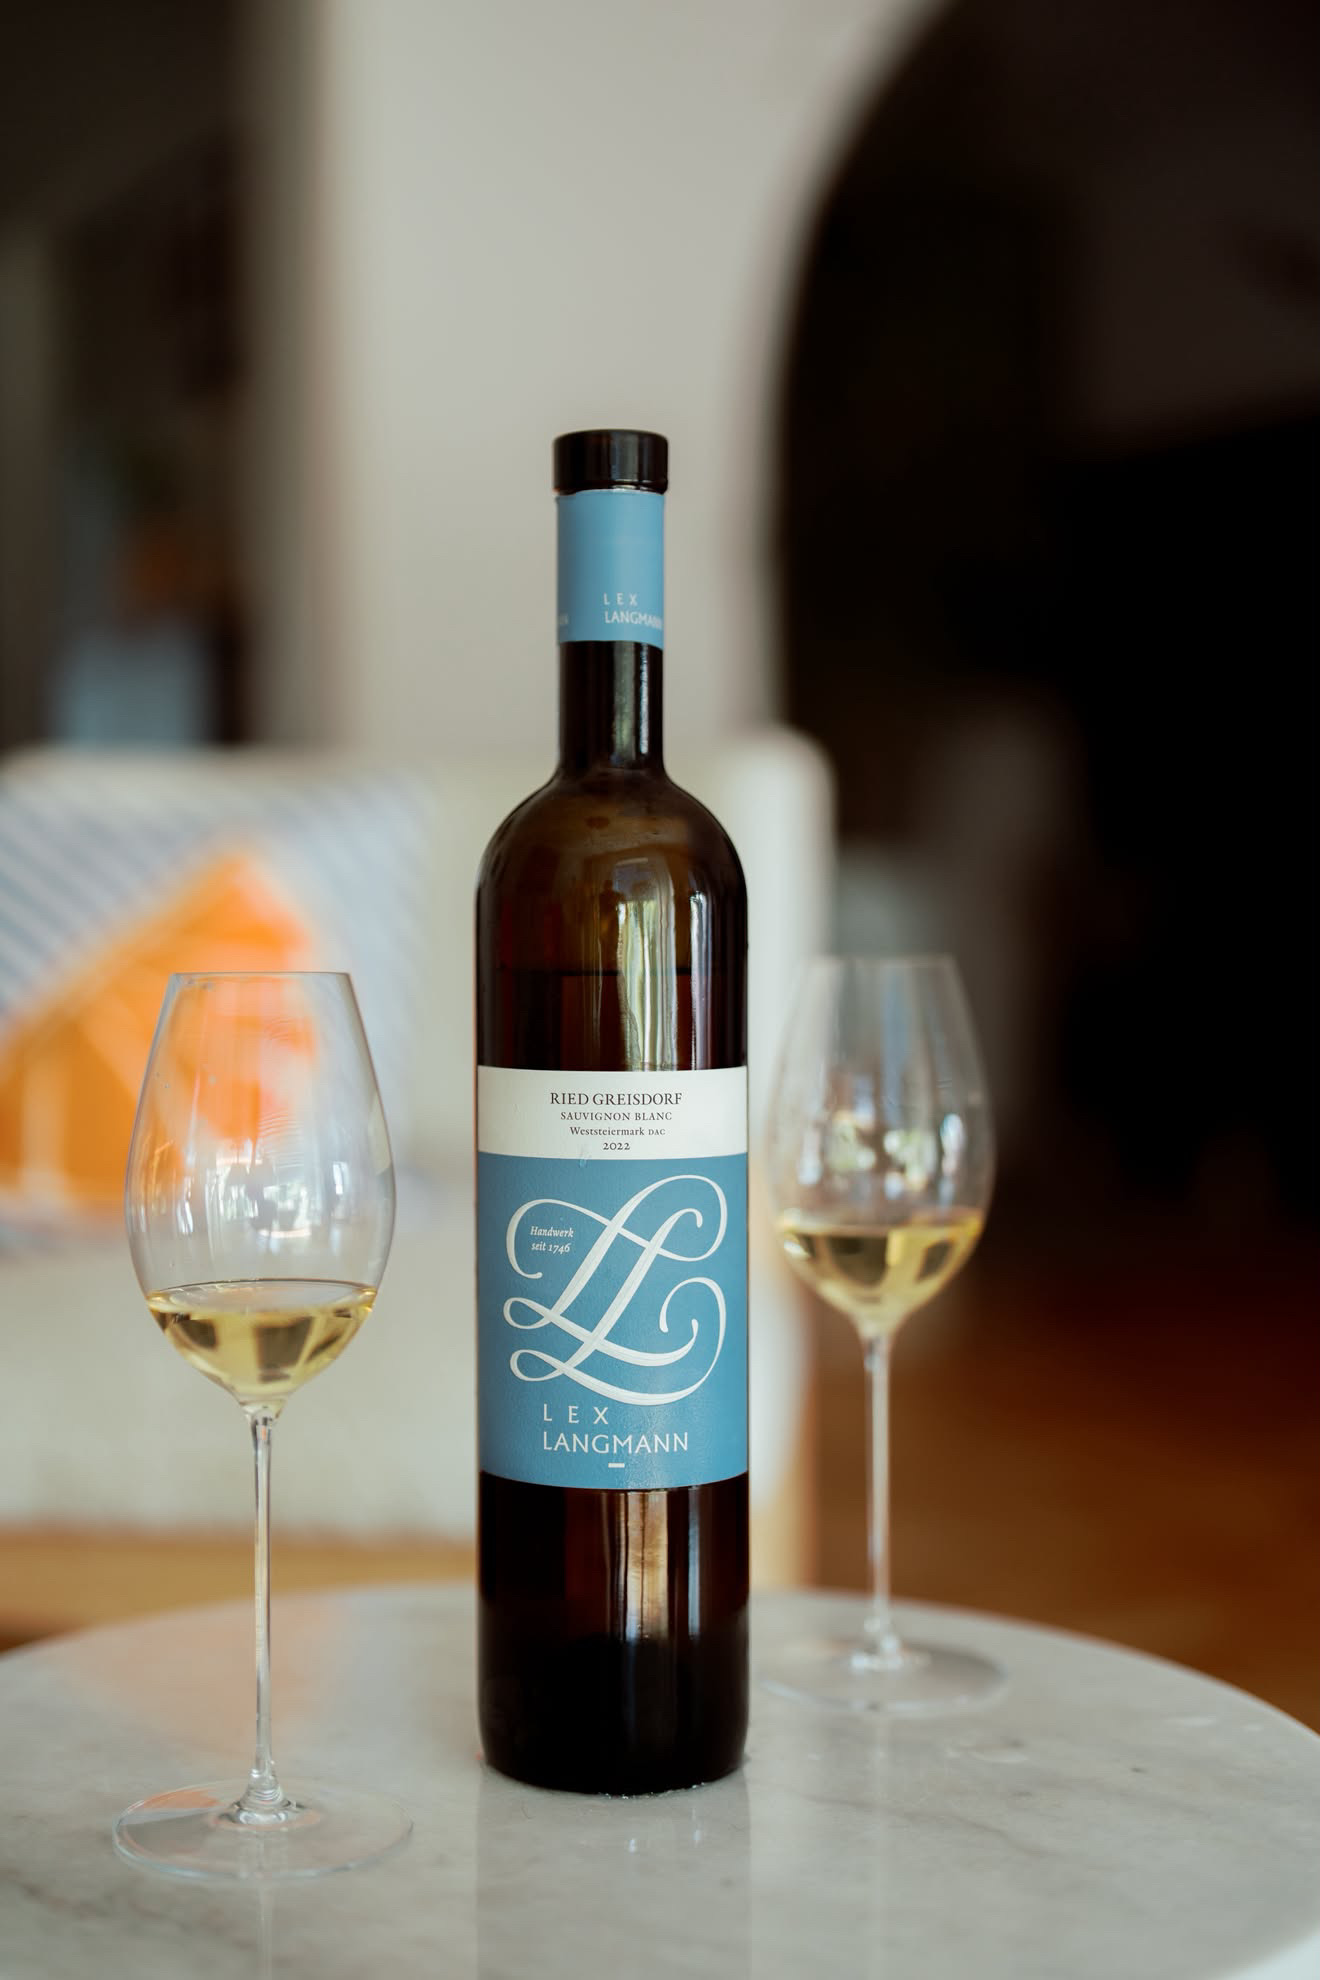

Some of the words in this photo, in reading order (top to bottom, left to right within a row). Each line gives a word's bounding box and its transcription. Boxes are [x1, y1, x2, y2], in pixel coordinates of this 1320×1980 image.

[603, 592, 638, 606] LEX
[550, 1092, 589, 1105] RIED
[592, 1092, 683, 1106] GREISDORF
[560, 1111, 631, 1121] SAUVIGNON
[634, 1111, 673, 1121] BLANC
[569, 1126, 645, 1136] Weststeiermark
[648, 1128, 666, 1136] DAC
[602, 1142, 631, 1151] 2022
[530, 1225, 574, 1238] Handwerk
[531, 1240, 547, 1251] seit
[548, 1242, 571, 1254] 1746
[543, 1403, 609, 1425] LEX
[543, 1431, 689, 1454] LANGMANN
